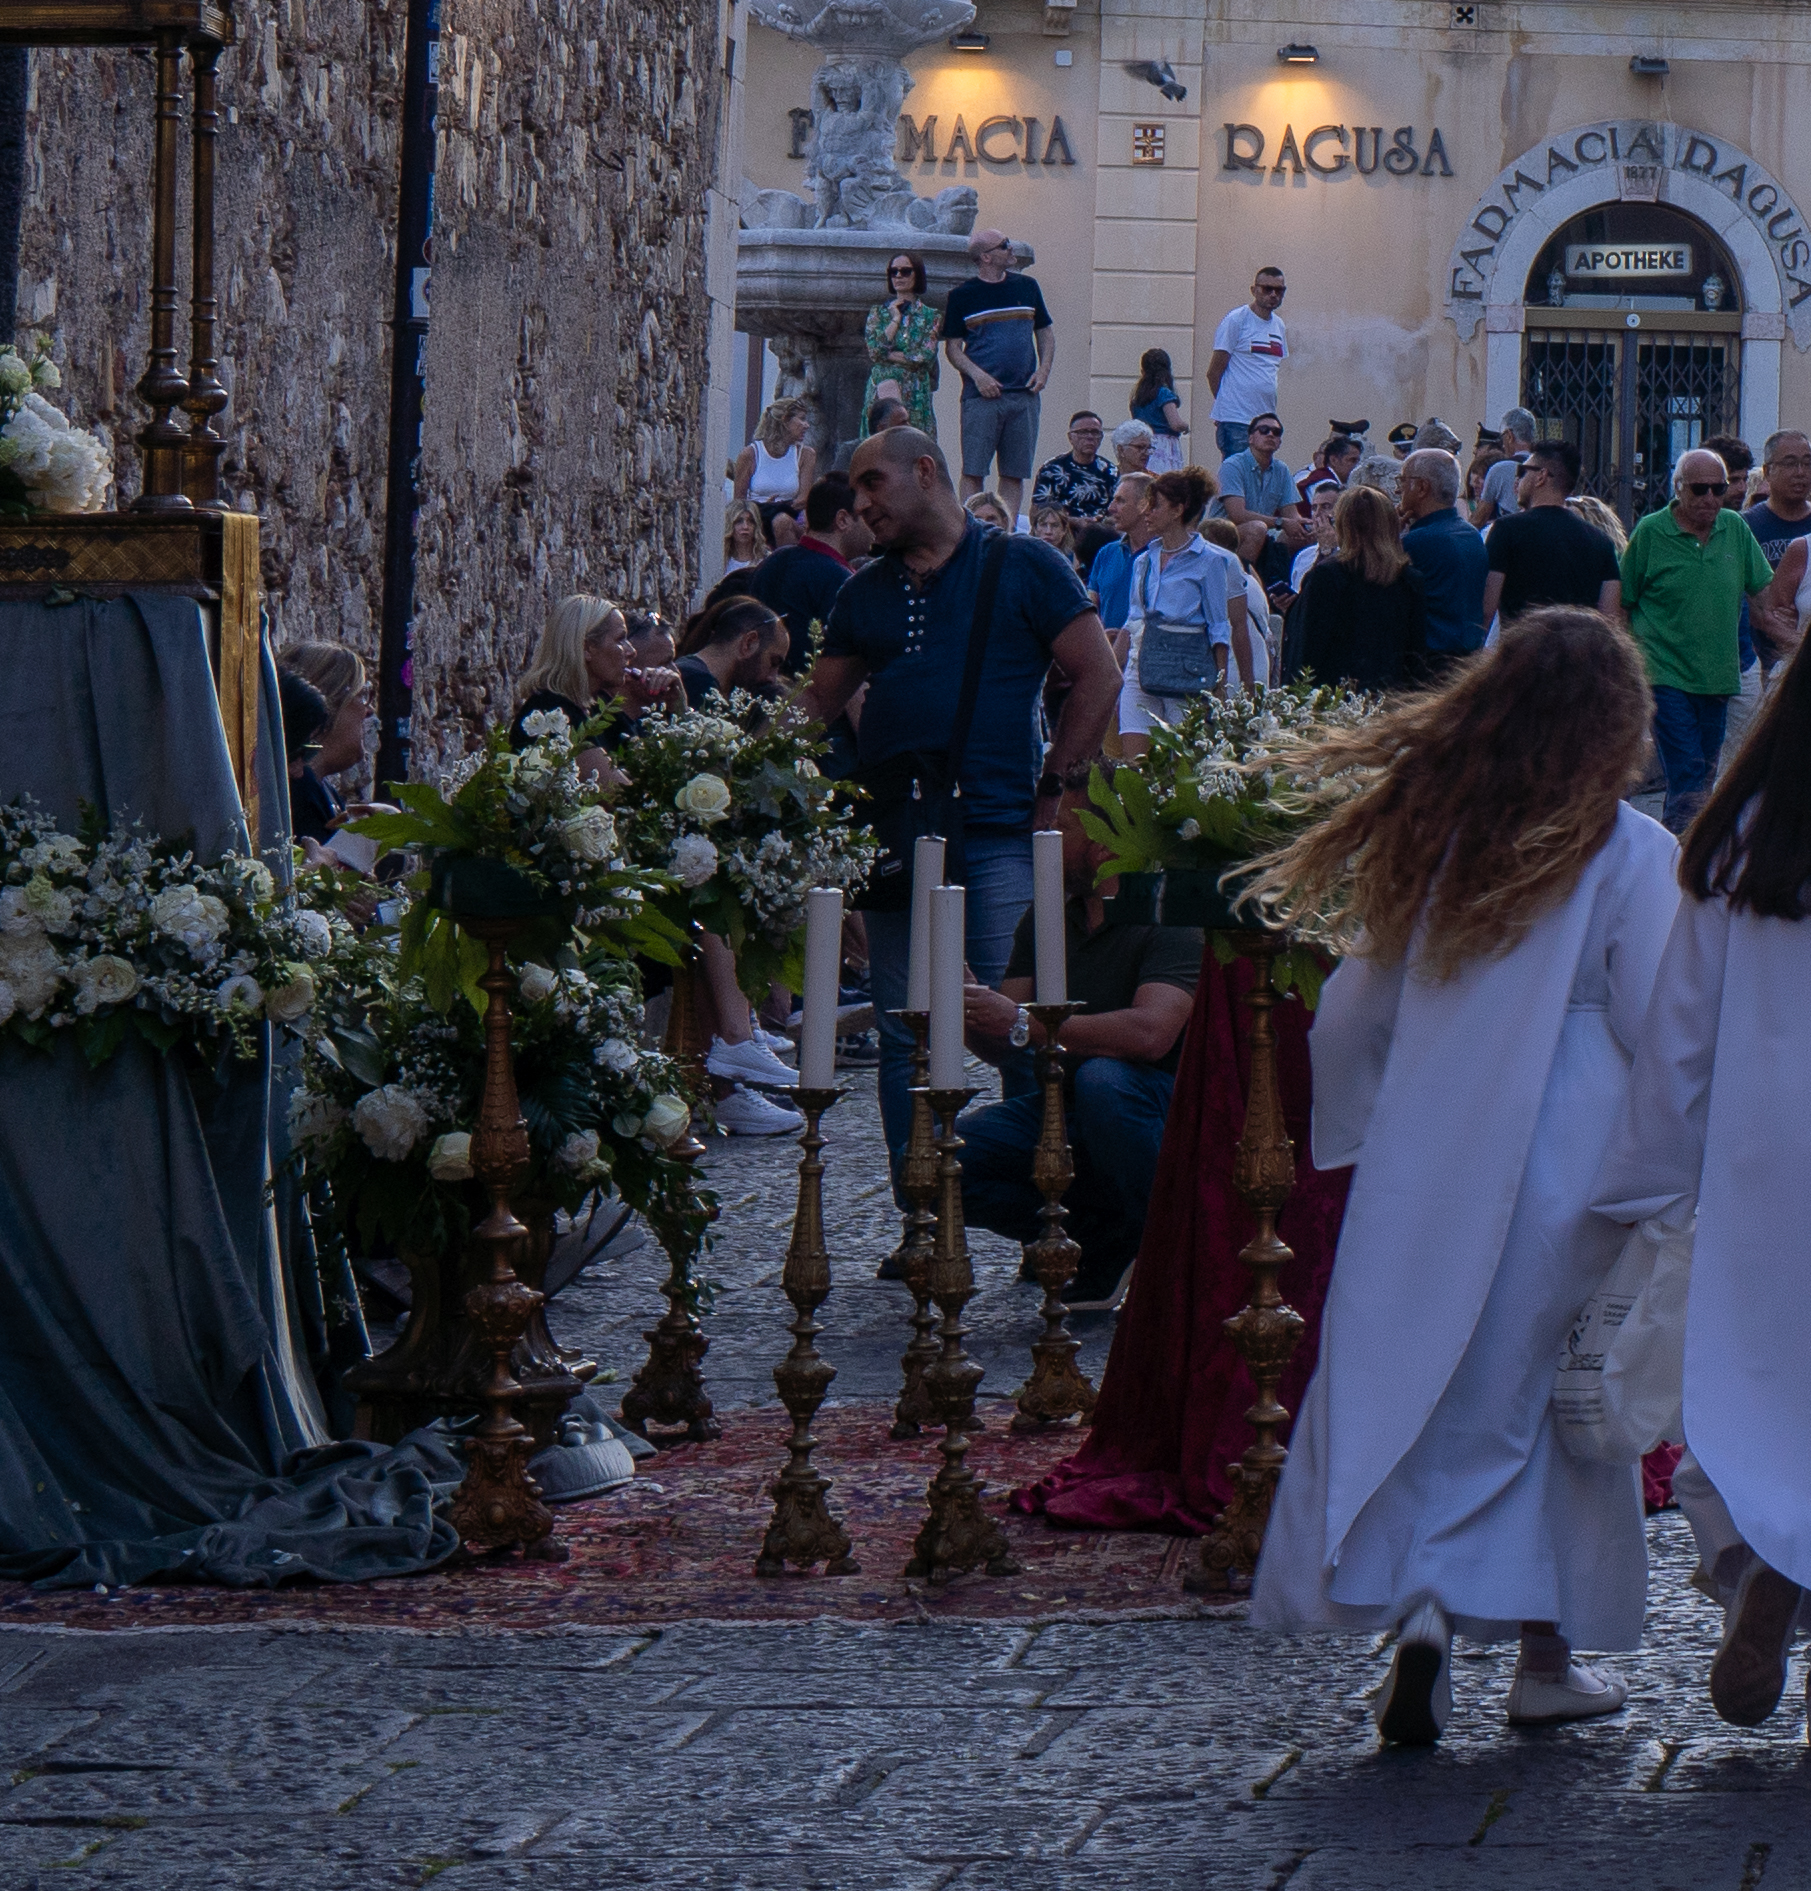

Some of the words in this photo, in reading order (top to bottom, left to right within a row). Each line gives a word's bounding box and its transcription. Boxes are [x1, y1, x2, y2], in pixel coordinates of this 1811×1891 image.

[787, 107, 1076, 165] FMACIA
[1223, 123, 1454, 176] RAGUSA
[1623, 165, 1657, 179] 1877
[1450, 127, 1662, 301] FARMACIA
[1574, 249, 1685, 271] APOTHEKE
